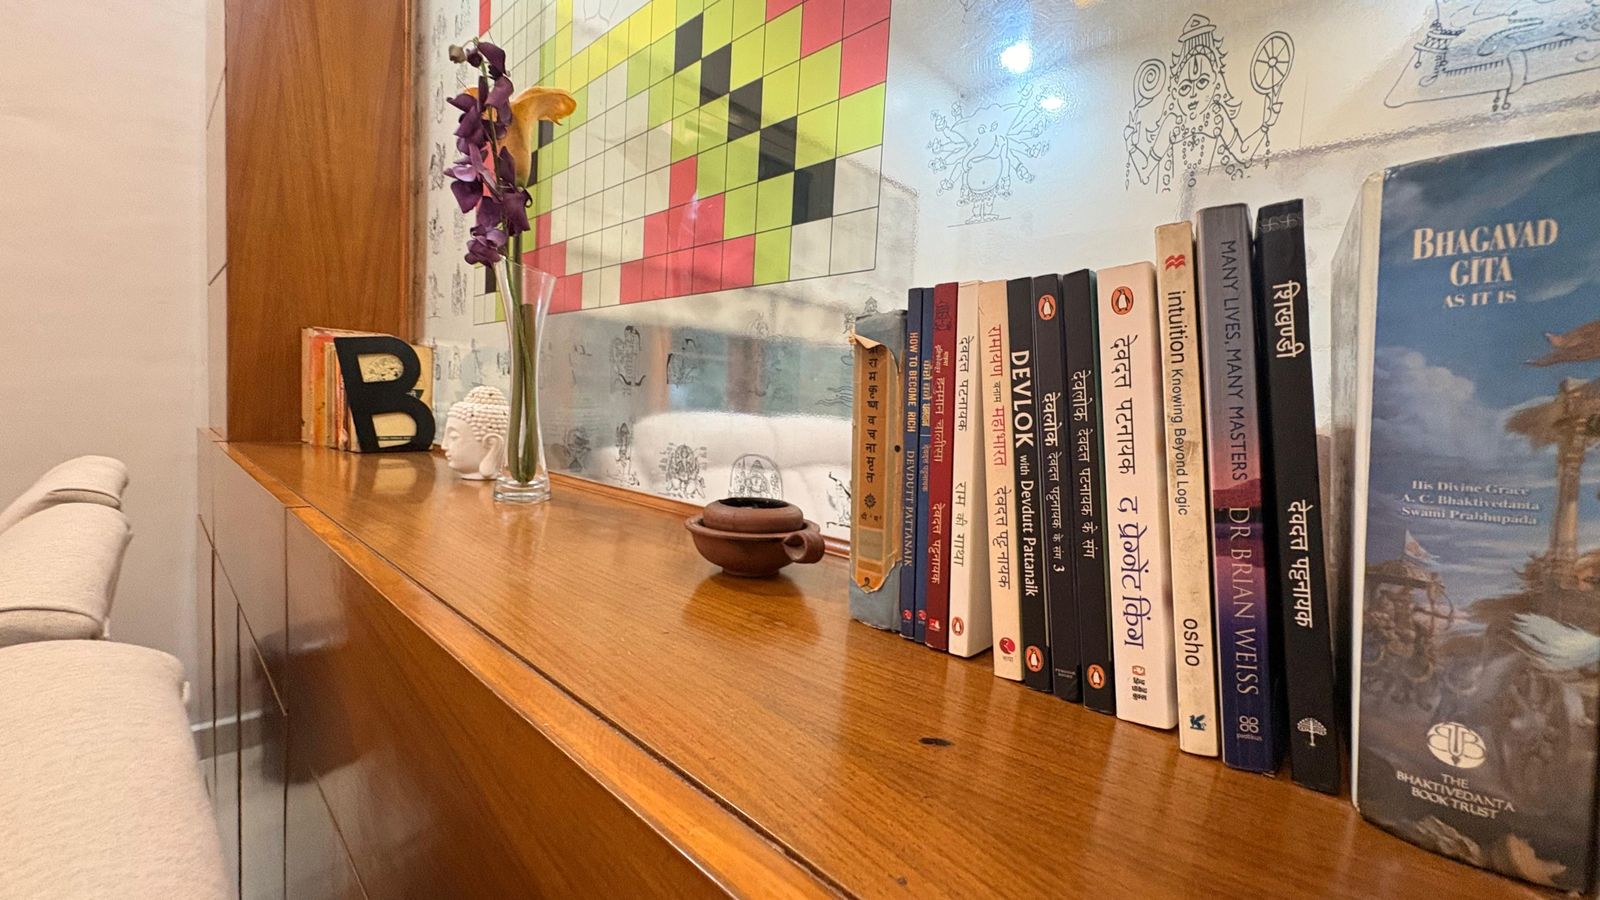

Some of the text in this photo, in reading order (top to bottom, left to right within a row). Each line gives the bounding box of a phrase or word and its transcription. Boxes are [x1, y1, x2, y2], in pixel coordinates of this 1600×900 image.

[1272, 279, 1305, 359] शिखण्डी
[1444, 289, 1517, 308] AS IT IS
[906, 332, 918, 433] HOW TO BECOME RICH
[958, 335, 975, 432] देवदत्त पटनायक
[1221, 239, 1248, 481] MANY LIVES, MANY MASTERS
[932, 377, 947, 463] हनुमान चालीसा
[988, 323, 1007, 467] रामायण बनाम महाभारत
[1042, 392, 1063, 446] देवलोक
[1110, 334, 1138, 475] देवदत्त पटनायक
[1168, 290, 1191, 516] intuition Knowing Beyond Logic
[1011, 350, 1039, 597] DEVLOK with Devdutt Pattanaik
[1046, 451, 1063, 481] देवदत्त
[1071, 370, 1099, 559] देवलोक देवदत्त पटनायक के संग
[1412, 479, 1530, 496] His Divine Grace
[904, 450, 916, 566] DEVDUTT PATTANAIK
[932, 502, 946, 534] देवदत्त
[954, 481, 968, 567] राम की गाथा
[994, 486, 1012, 526] देवदत्त
[1118, 496, 1138, 514] द
[1288, 499, 1314, 551] देवदत्त
[1401, 506, 1538, 526] Swami Prabhupada
[1438, 495, 1540, 511] Bhaktivedanta
[1053, 533, 1064, 542] के
[1053, 546, 1065, 559] संग
[1053, 564, 1066, 572] 3
[1123, 595, 1152, 649] किंग
[1229, 507, 1259, 695] DR BRIAN WEISS
[1183, 617, 1204, 667] osho
[1396, 770, 1516, 813] BHAKTIVEDANTA
[1411, 786, 1500, 820] BOOK TRUST
[1441, 773, 1469, 789] THE
